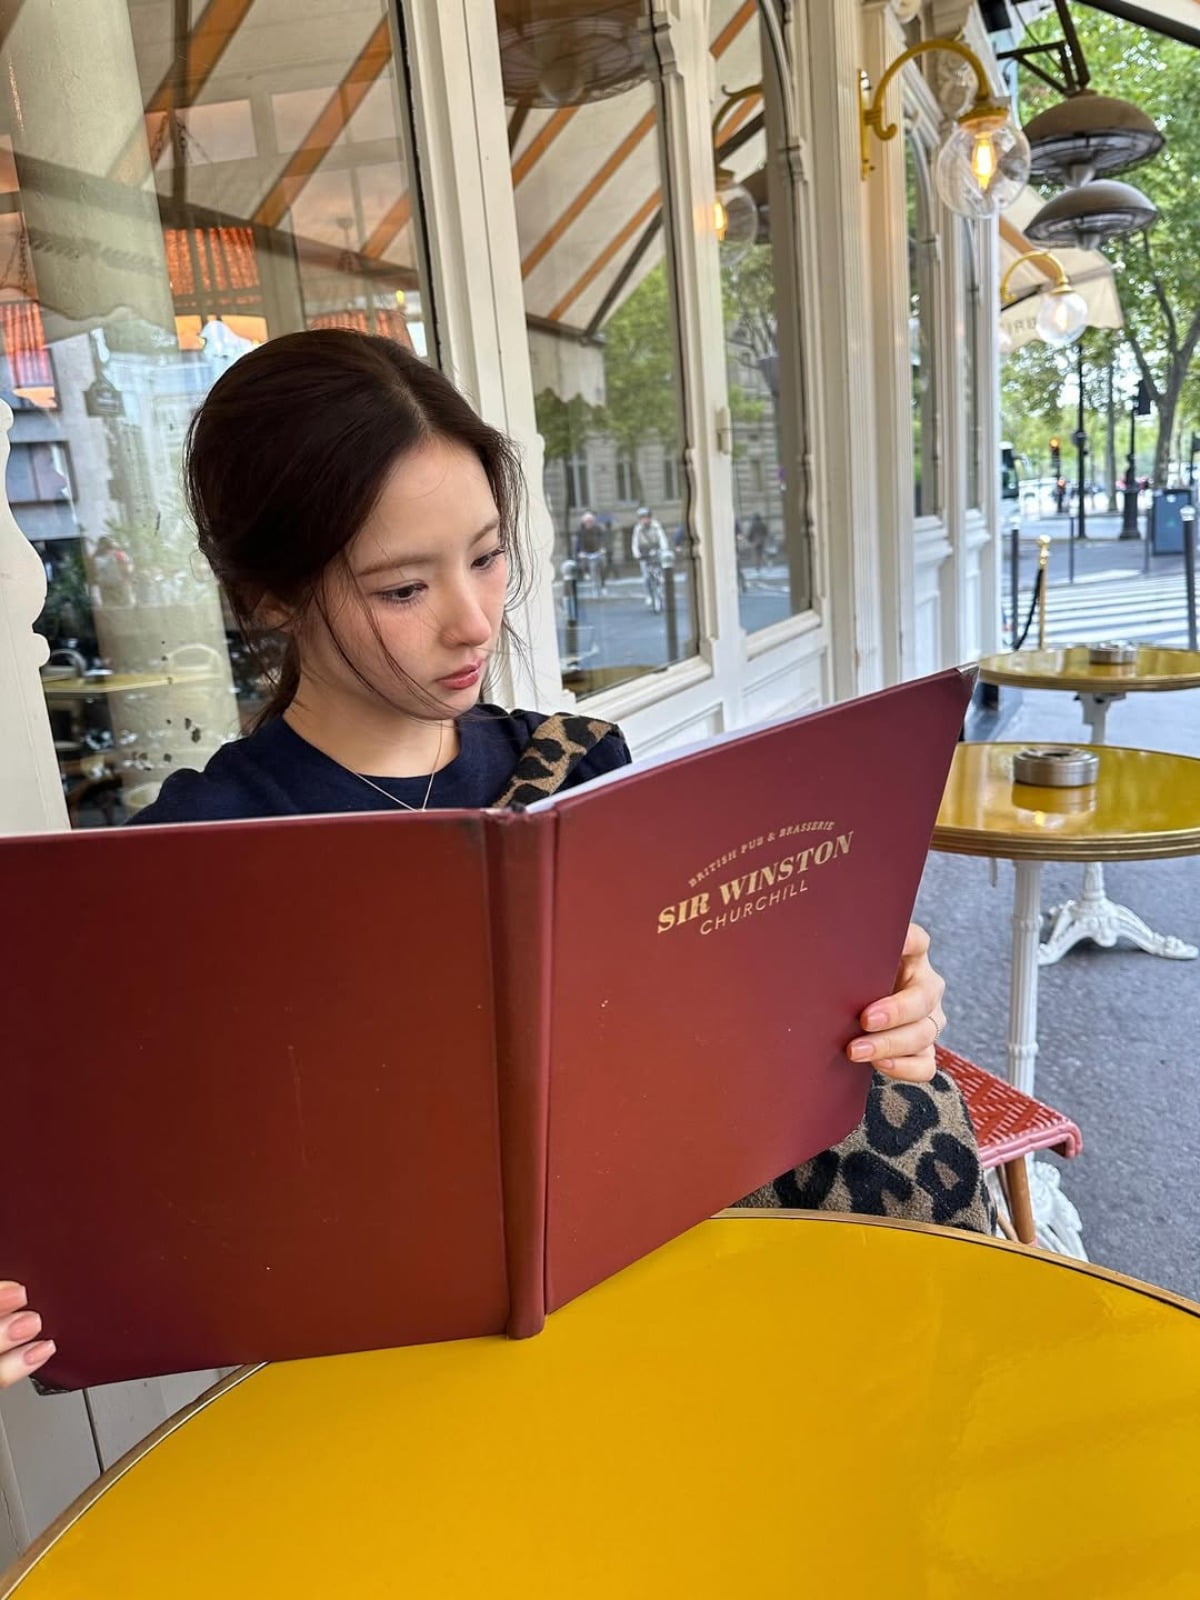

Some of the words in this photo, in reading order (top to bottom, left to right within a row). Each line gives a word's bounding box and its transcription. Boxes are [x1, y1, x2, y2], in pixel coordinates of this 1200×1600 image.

[657, 892, 711, 934] SIR
[719, 830, 855, 907] WINSTON
[688, 849, 737, 888] BRITISH
[741, 836, 764, 854] PUB
[767, 832, 776, 842] &
[779, 820, 836, 838] BRASSERIE
[699, 879, 809, 936] CHURCHILL
